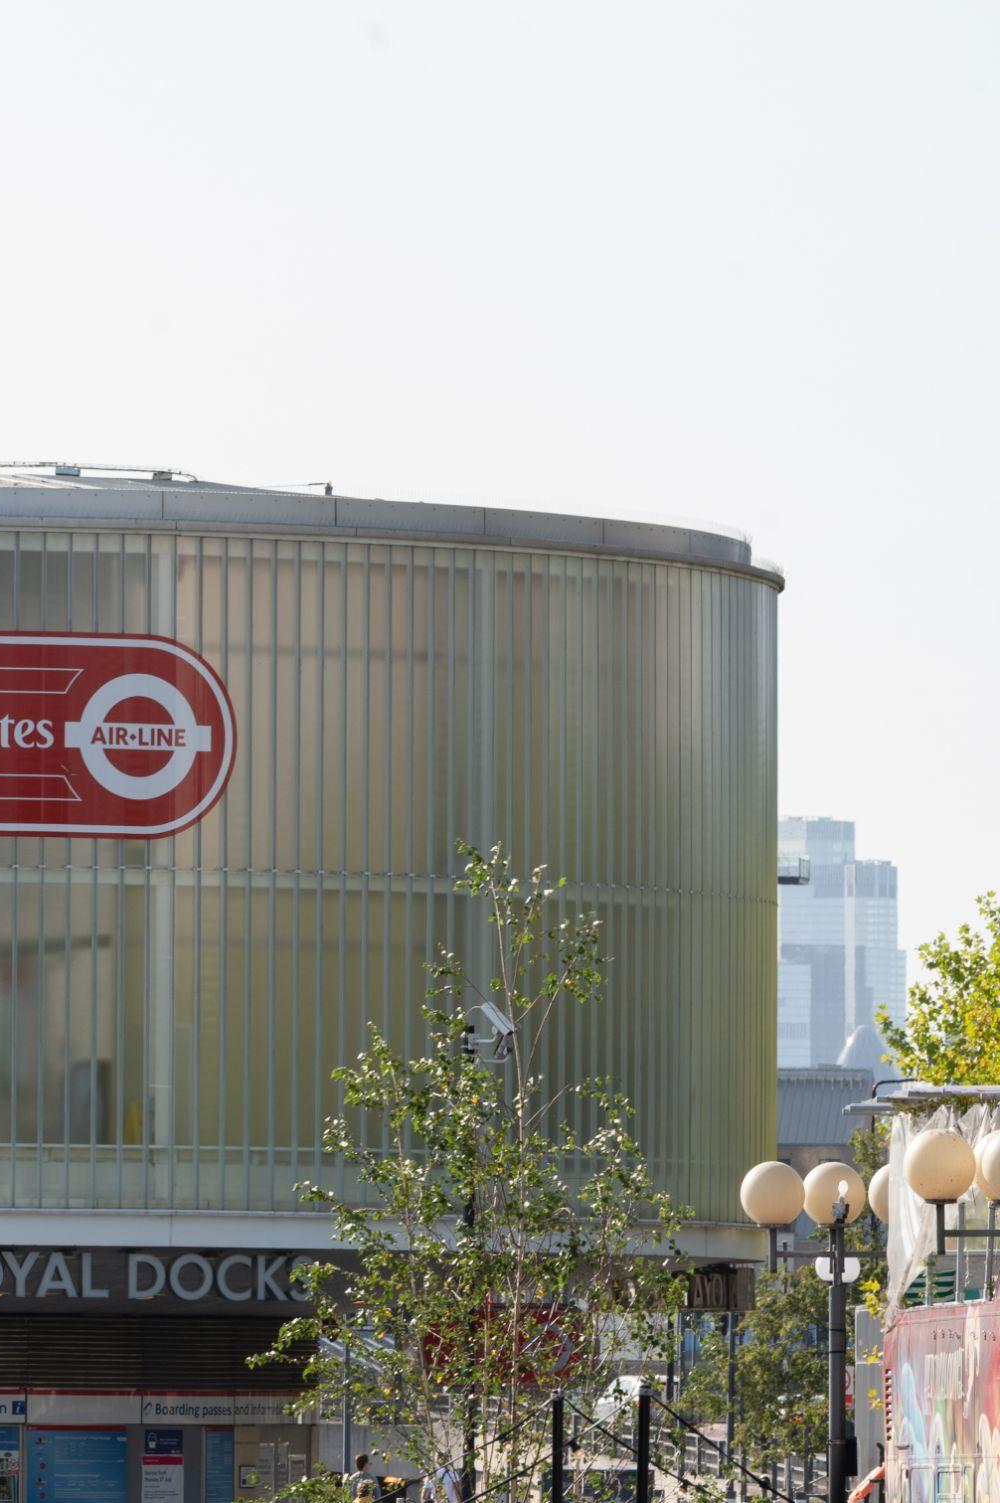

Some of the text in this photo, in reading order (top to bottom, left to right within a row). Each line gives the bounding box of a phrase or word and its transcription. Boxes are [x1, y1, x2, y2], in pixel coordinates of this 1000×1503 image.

[155, 1403, 200, 1417] Boarding
[202, 1406, 232, 1417] passes
[234, 1403, 250, 1415] and
